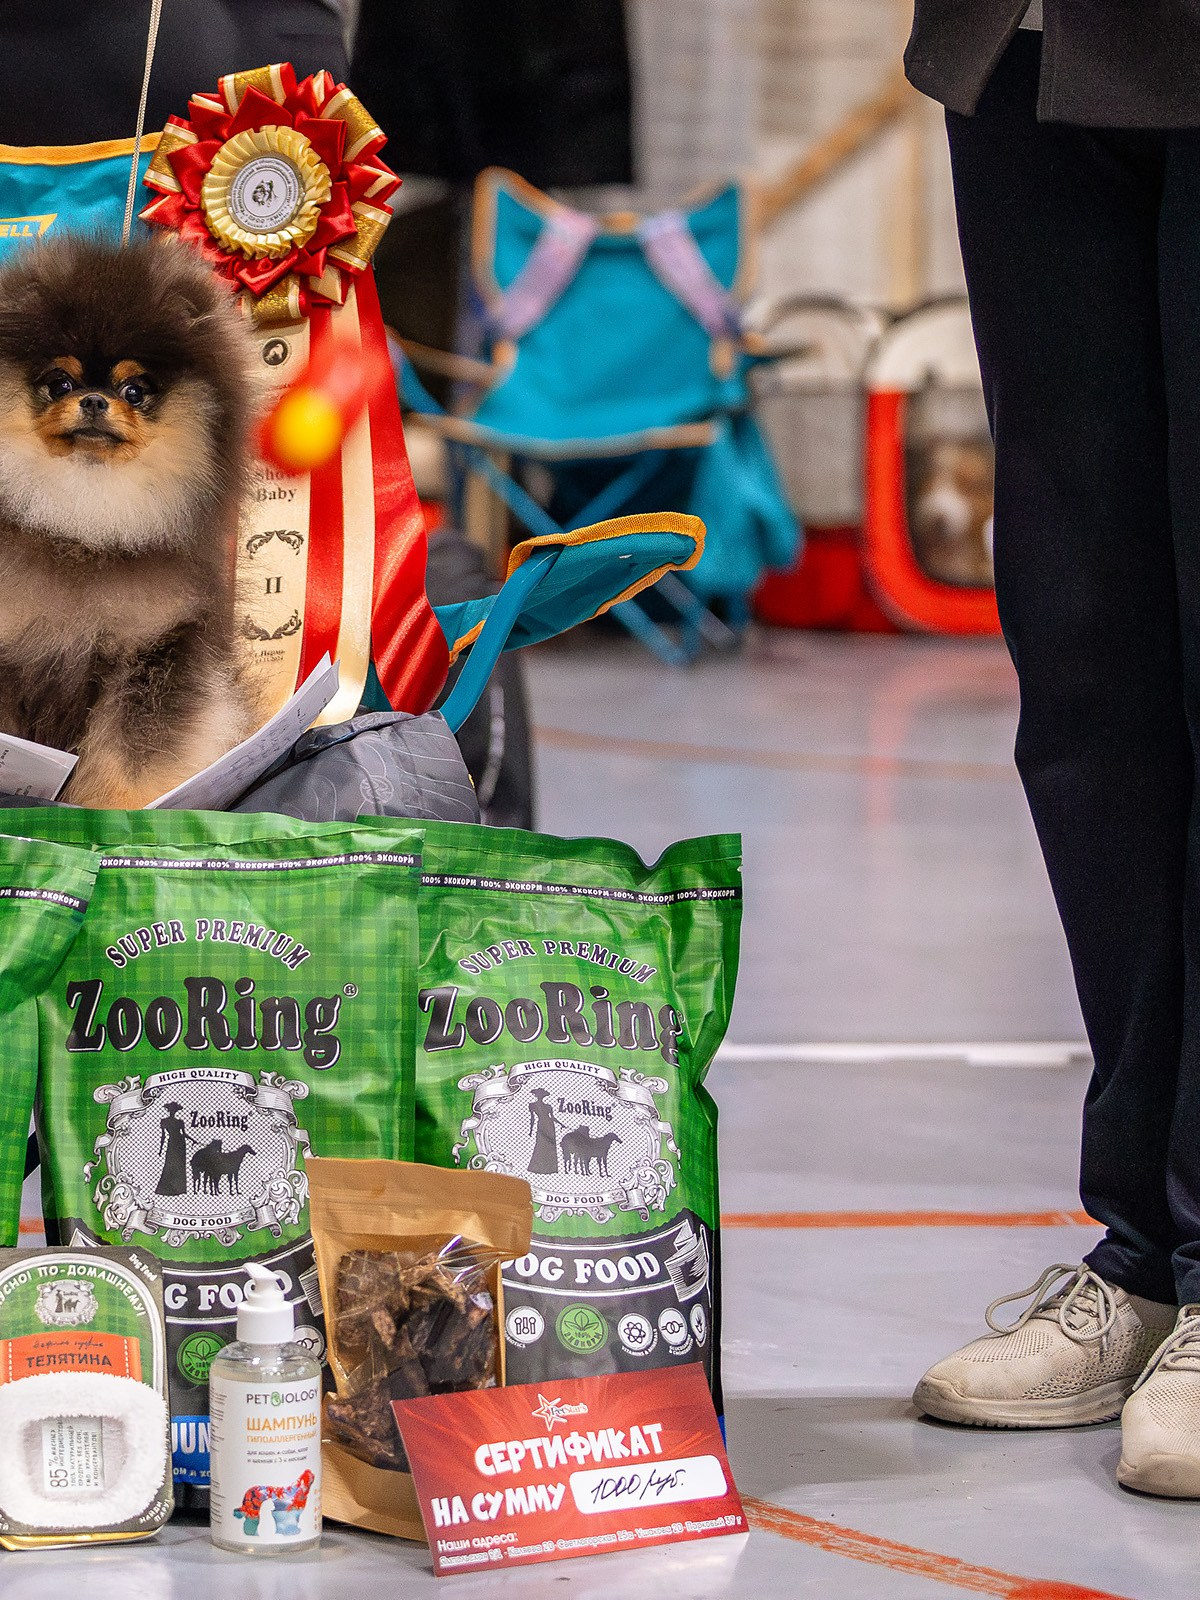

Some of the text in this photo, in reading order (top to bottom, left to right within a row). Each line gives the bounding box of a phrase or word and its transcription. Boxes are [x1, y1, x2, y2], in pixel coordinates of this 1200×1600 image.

[256, 486, 297, 503] Baby
[264, 576, 283, 594] II
[134, 853, 415, 870] 100% ЭКОКОРМ 100% ЭКОКОРМ 100% ЭКОКОРМ 100% ЭКОКОРМ
[15, 888, 39, 899] 100%
[41, 890, 81, 909] ЭКОКОРМ
[421, 875, 736, 904] 100% ЭКОКОРМ 100% ЭКОКОРМ 100% ЭКОКОРМ 100% ЭКОКОРМ 100% ЭКОКОРМ
[104, 917, 312, 972] SUPER PREMIUM
[459, 939, 658, 985] SUPER PREMIUM
[65, 976, 341, 1071] ZooRing
[417, 981, 685, 1067] ZooRing
[158, 1070, 240, 1082] HIGH QUALITY
[524, 1061, 601, 1075] HIGH QUALITY
[190, 1110, 248, 1132] ZooRing
[557, 1098, 613, 1122] ZooRing
[545, 1193, 604, 1204] DOG FOOD
[172, 1215, 232, 1227] DOG FOOD
[129, 1253, 158, 1282] Dog Food
[501, 1251, 660, 1284] OG FOOD
[37, 1264, 147, 1318] ПО-ДОМАШНЕМУ!
[26, 1352, 113, 1368] ТЕЛЯТИНА
[246, 1412, 318, 1431] ШАМПУНЬ
[474, 1422, 663, 1477] СЕРТИФИКАТ
[589, 1472, 642, 1505] 1000
[431, 1481, 568, 1529] НА СУММУ
[436, 1531, 519, 1552] Наши адреса:
